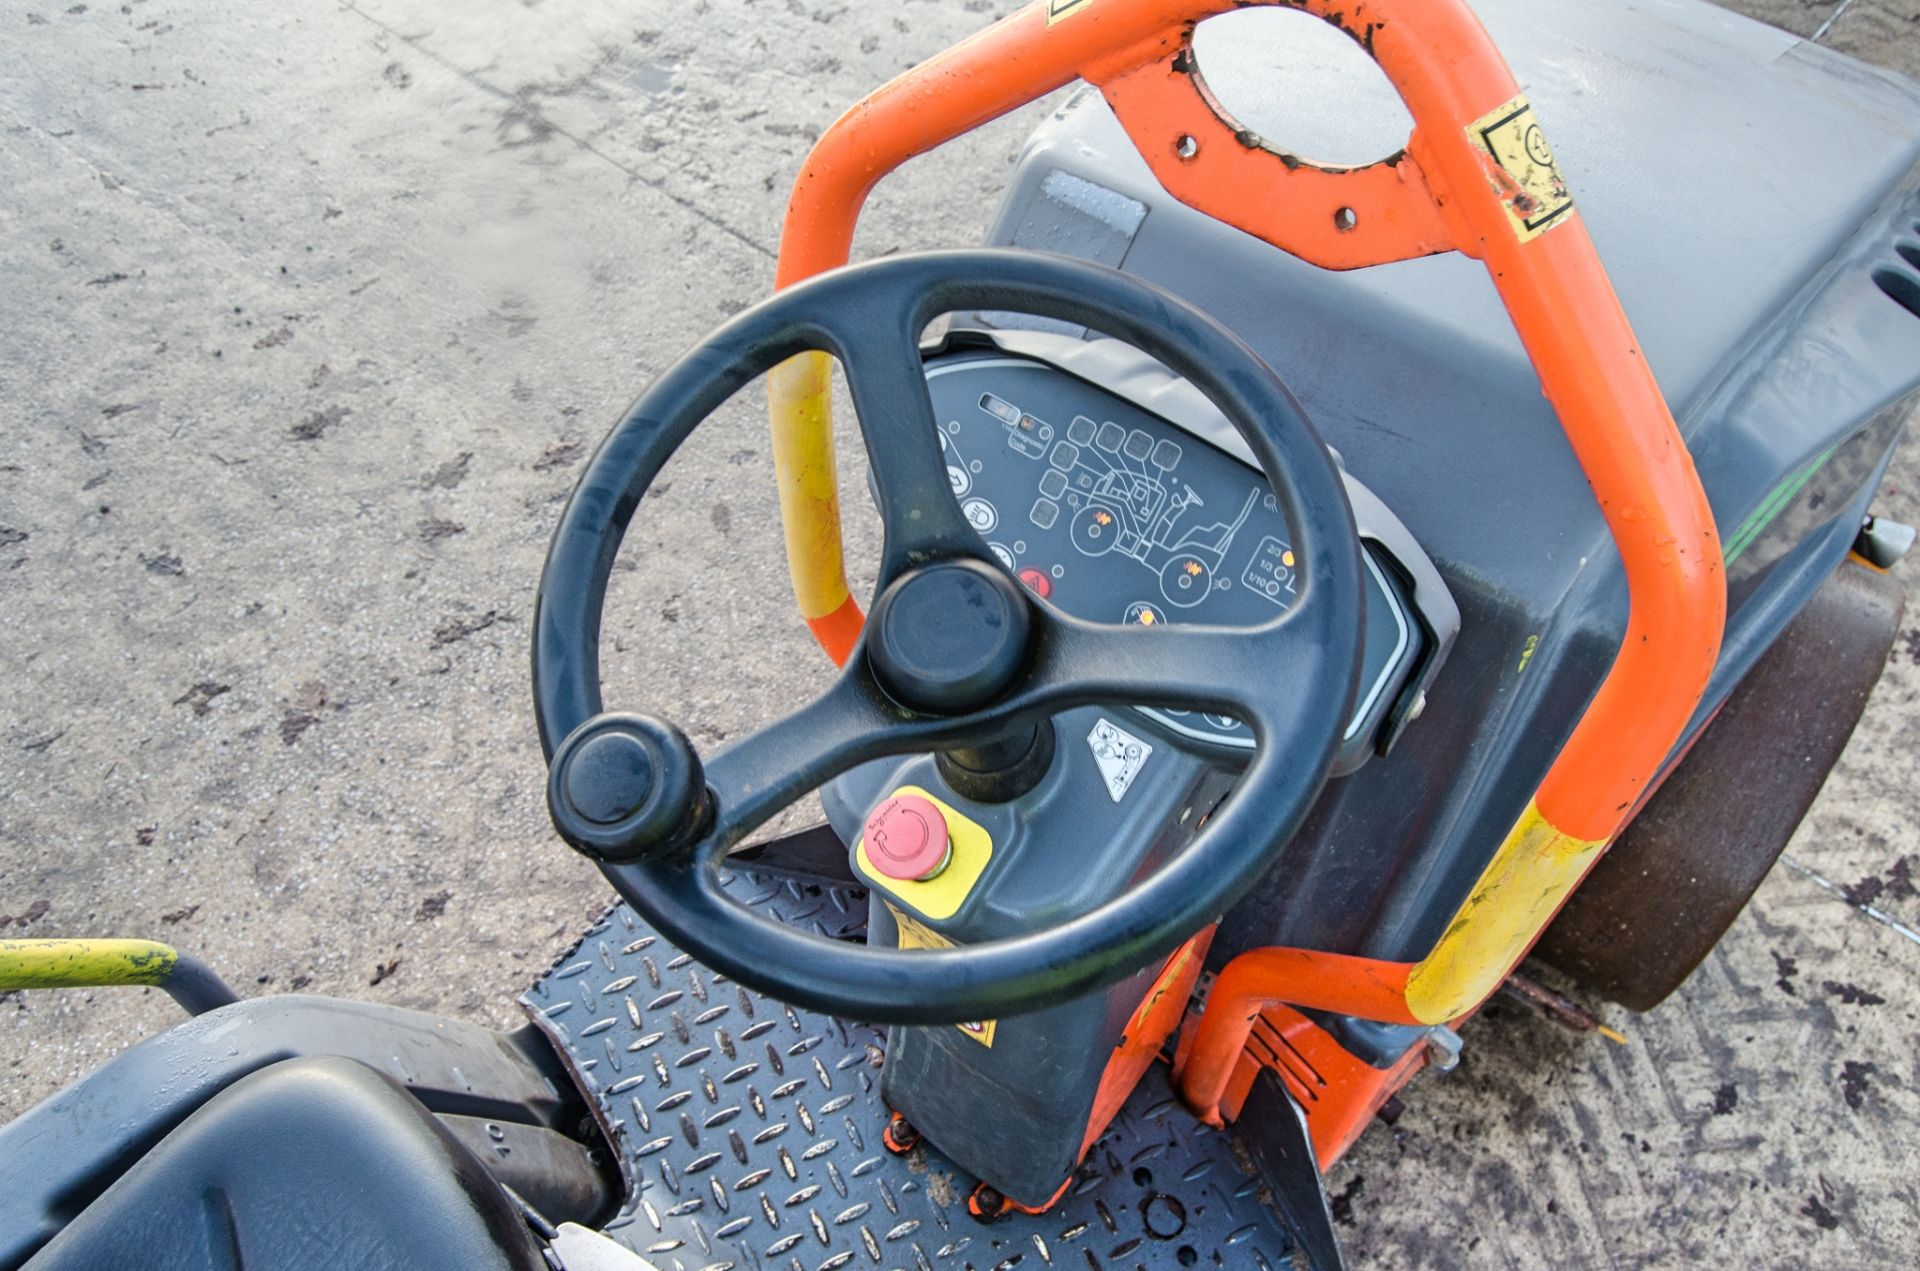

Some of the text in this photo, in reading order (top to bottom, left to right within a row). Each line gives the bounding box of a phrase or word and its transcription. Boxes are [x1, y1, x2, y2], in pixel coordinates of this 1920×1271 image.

[1010, 438, 1026, 452] Code
[1014, 428, 1045, 451] Diagnostic
[1266, 543, 1282, 557] 2/3
[1260, 559, 1273, 573] 1/3
[1249, 572, 1267, 588] 1/10
